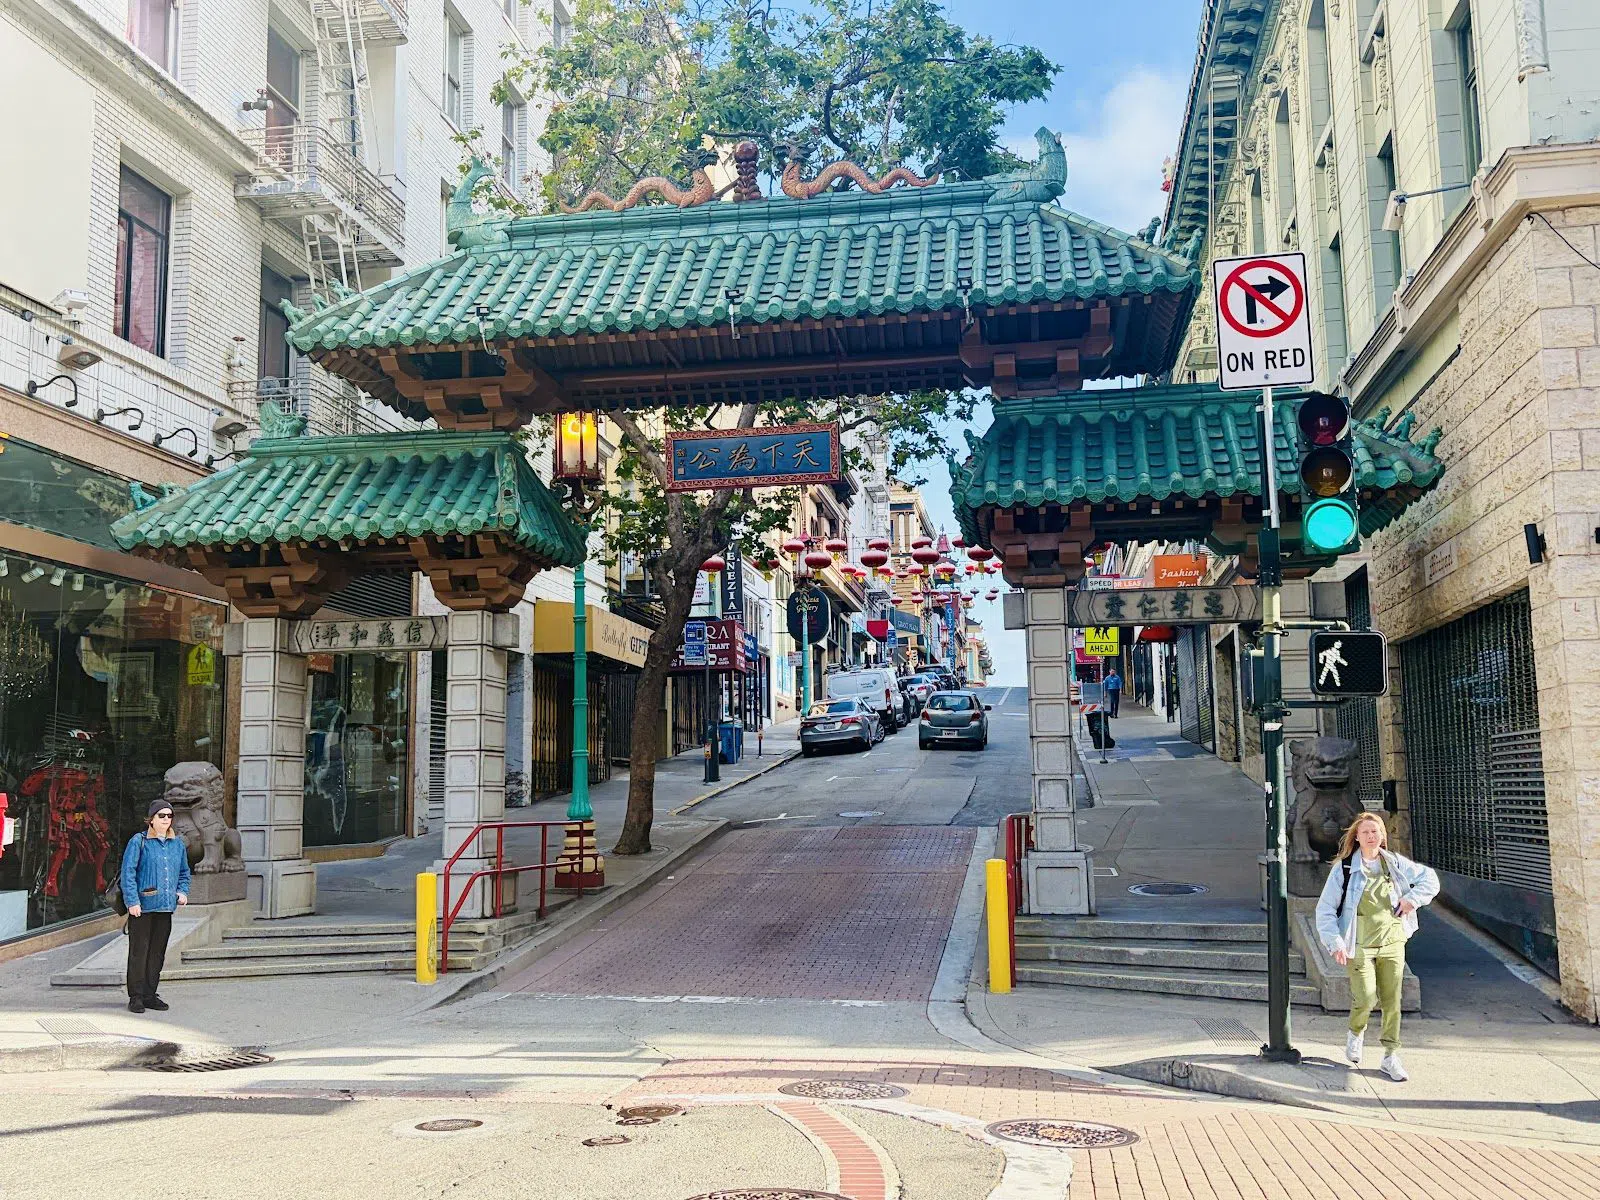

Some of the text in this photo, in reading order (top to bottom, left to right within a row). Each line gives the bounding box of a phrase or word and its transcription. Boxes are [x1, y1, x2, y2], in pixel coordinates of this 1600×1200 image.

[1226, 348, 1305, 372] ON RED
[726, 542, 738, 610] VENEZIA
[1159, 568, 1200, 579] Fashion
[723, 613, 743, 621] SALE
[1090, 645, 1114, 653] AHEAD
